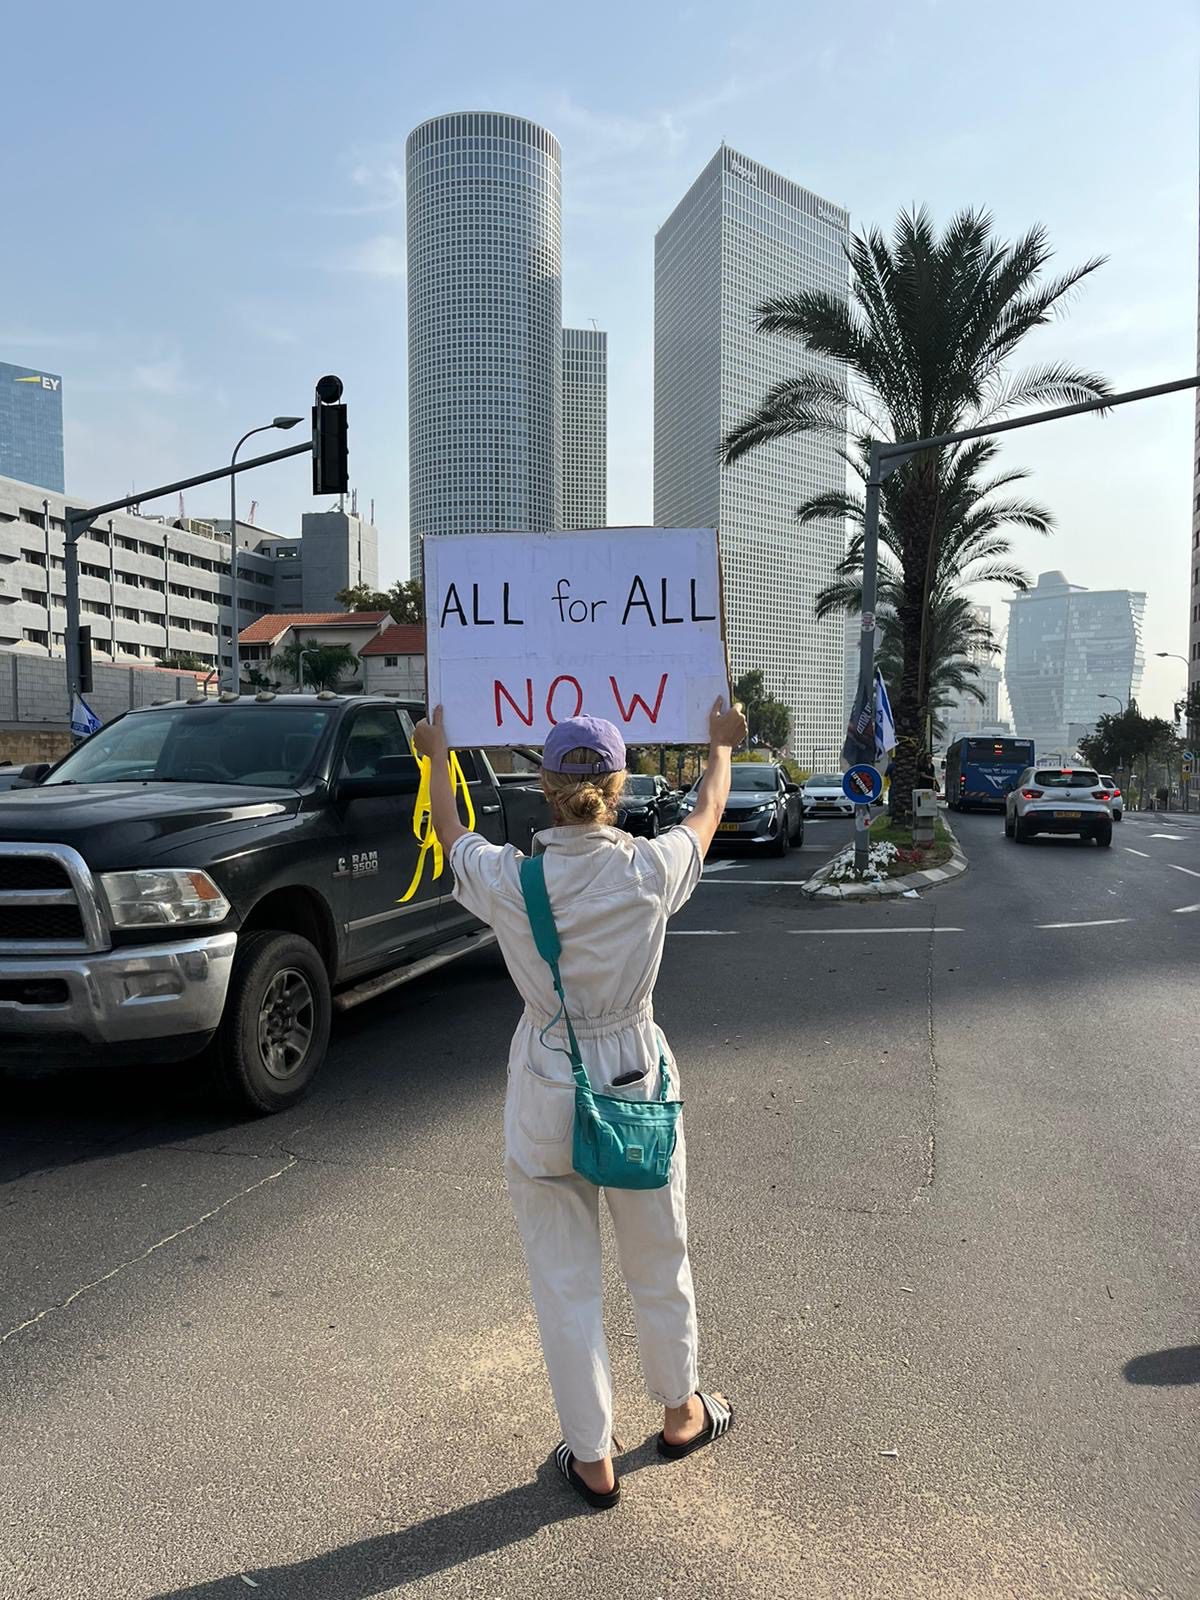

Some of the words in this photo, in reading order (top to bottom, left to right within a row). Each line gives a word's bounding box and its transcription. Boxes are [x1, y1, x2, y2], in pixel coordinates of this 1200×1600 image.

[42, 376, 60, 391] EY
[440, 582, 524, 628] ALL
[551, 578, 607, 623] for
[622, 575, 716, 627] ALL
[494, 673, 668, 727] NOW
[351, 851, 378, 863] RAM
[352, 860, 378, 872] 3500
